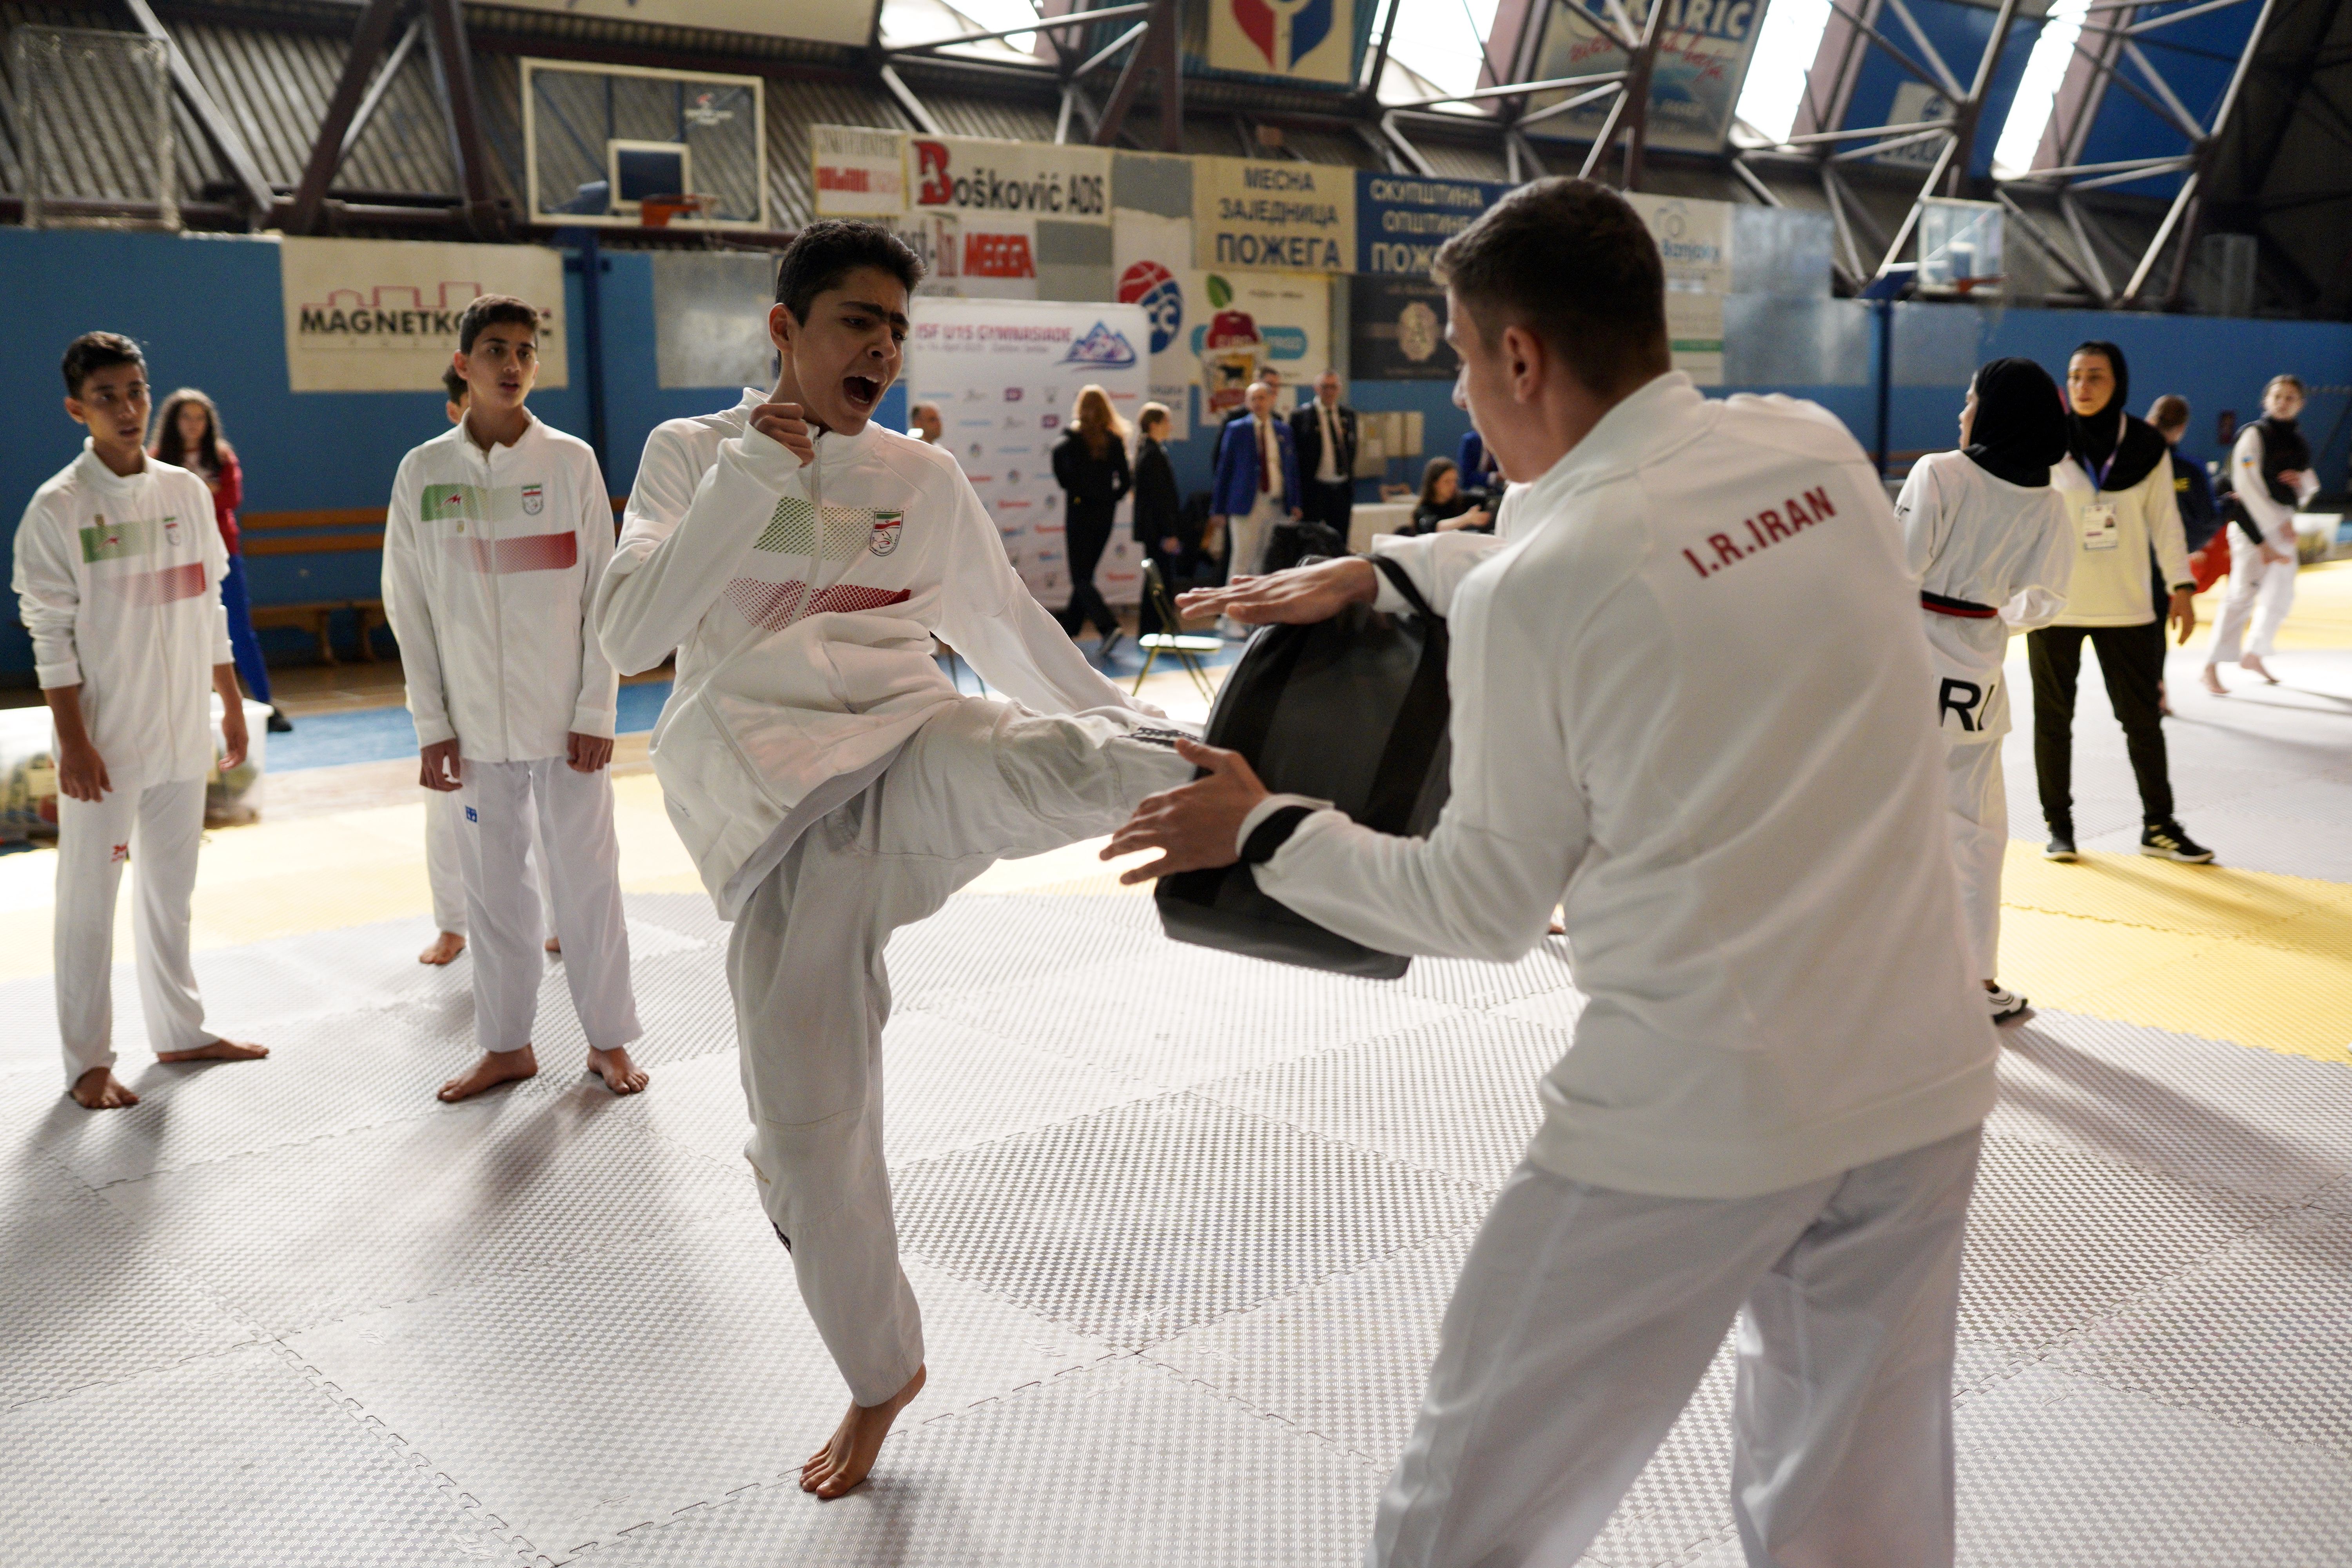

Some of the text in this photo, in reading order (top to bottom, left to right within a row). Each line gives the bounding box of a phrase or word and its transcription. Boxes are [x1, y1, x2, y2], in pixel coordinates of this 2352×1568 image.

[913, 140, 1063, 212] Bošković
[1068, 174, 1103, 215] ADS
[1244, 167, 1316, 192] МЕСНА
[1370, 179, 1484, 208] СКУПШТИНА
[1218, 197, 1340, 229] ЗАЈЕДНИЦА
[1216, 232, 1342, 267] ПОЖЕГА
[1371, 241, 1441, 273] ПОЖ
[1682, 486, 1837, 578] I.R.IRAN
